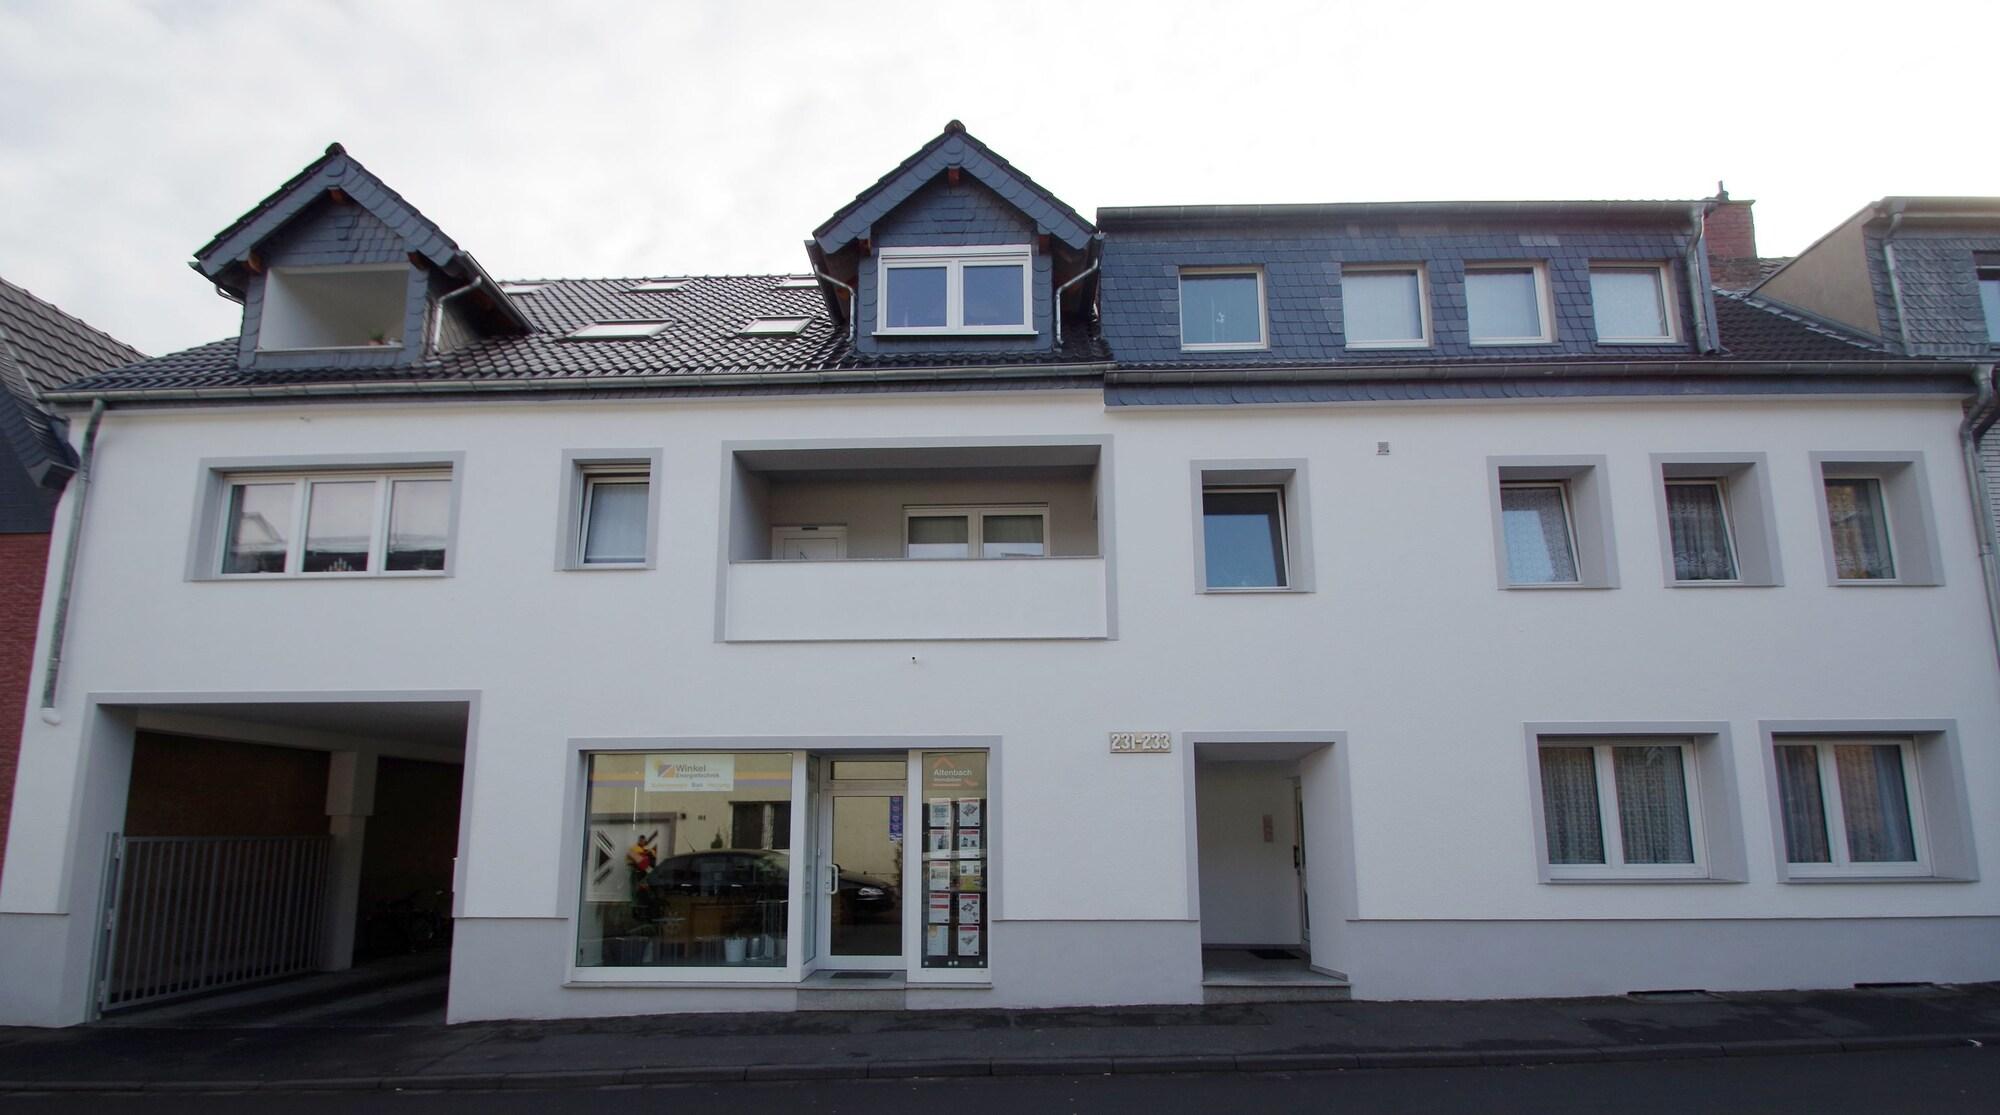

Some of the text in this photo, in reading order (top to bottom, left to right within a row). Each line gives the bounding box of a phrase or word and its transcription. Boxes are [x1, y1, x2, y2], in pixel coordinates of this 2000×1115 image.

[1111, 733, 1169, 750] 231-233
[675, 764, 706, 772] Winkel
[934, 768, 972, 776] Altenbach
